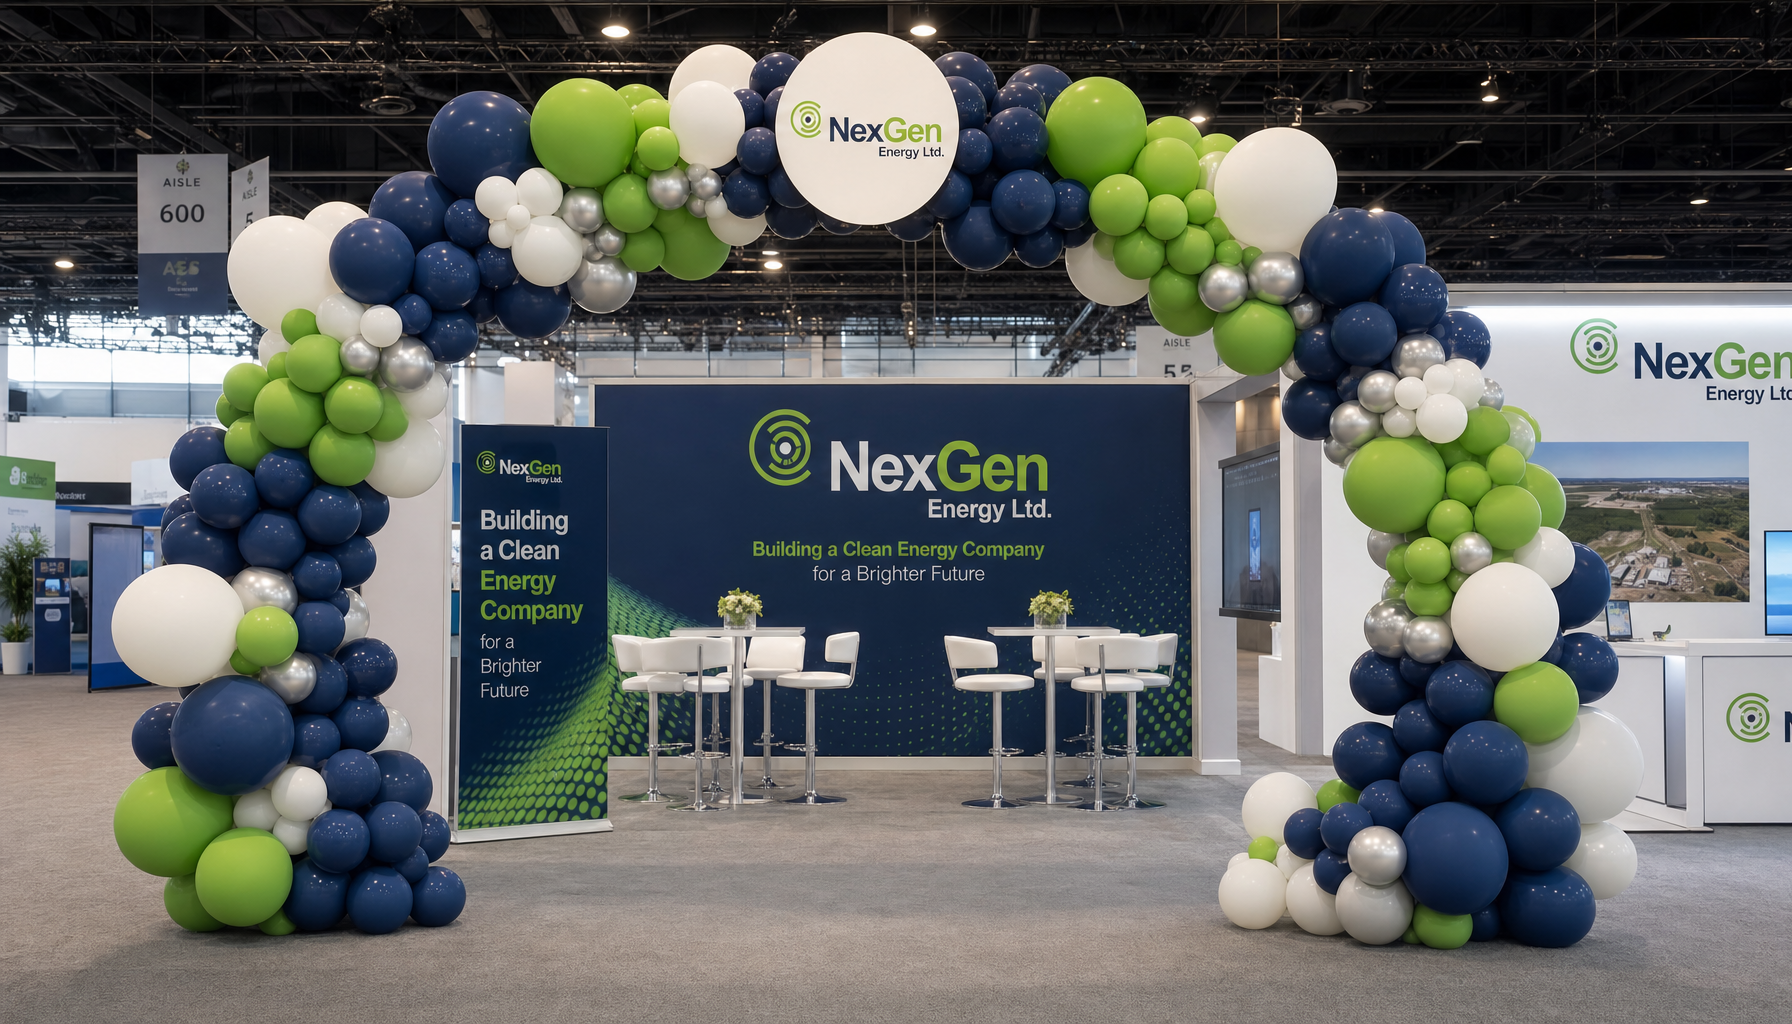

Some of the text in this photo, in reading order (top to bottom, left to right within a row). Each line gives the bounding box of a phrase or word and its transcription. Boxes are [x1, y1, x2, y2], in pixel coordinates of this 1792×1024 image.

[830, 117, 941, 142] NexGen
[879, 147, 944, 159] Energy Ltd.
[163, 178, 200, 187] AISLE
[160, 204, 204, 223] 600
[1163, 338, 1191, 347] AISLE
[1635, 342, 1792, 379] NexGen
[1707, 386, 1764, 404] Energy
[500, 459, 561, 474] NexGen
[831, 441, 1047, 492] NexGen
[929, 499, 1051, 523] Energy Ltd.
[481, 510, 568, 535] Building
[480, 539, 559, 561] a Clean
[753, 541, 1044, 560] Building a Clean Energy Company
[481, 570, 556, 595] Energy
[812, 566, 984, 585] for a Brighter Future
[481, 600, 583, 624] Company
[479, 634, 514, 649] for a
[482, 658, 541, 677] Brighter
[481, 683, 529, 698] Future
